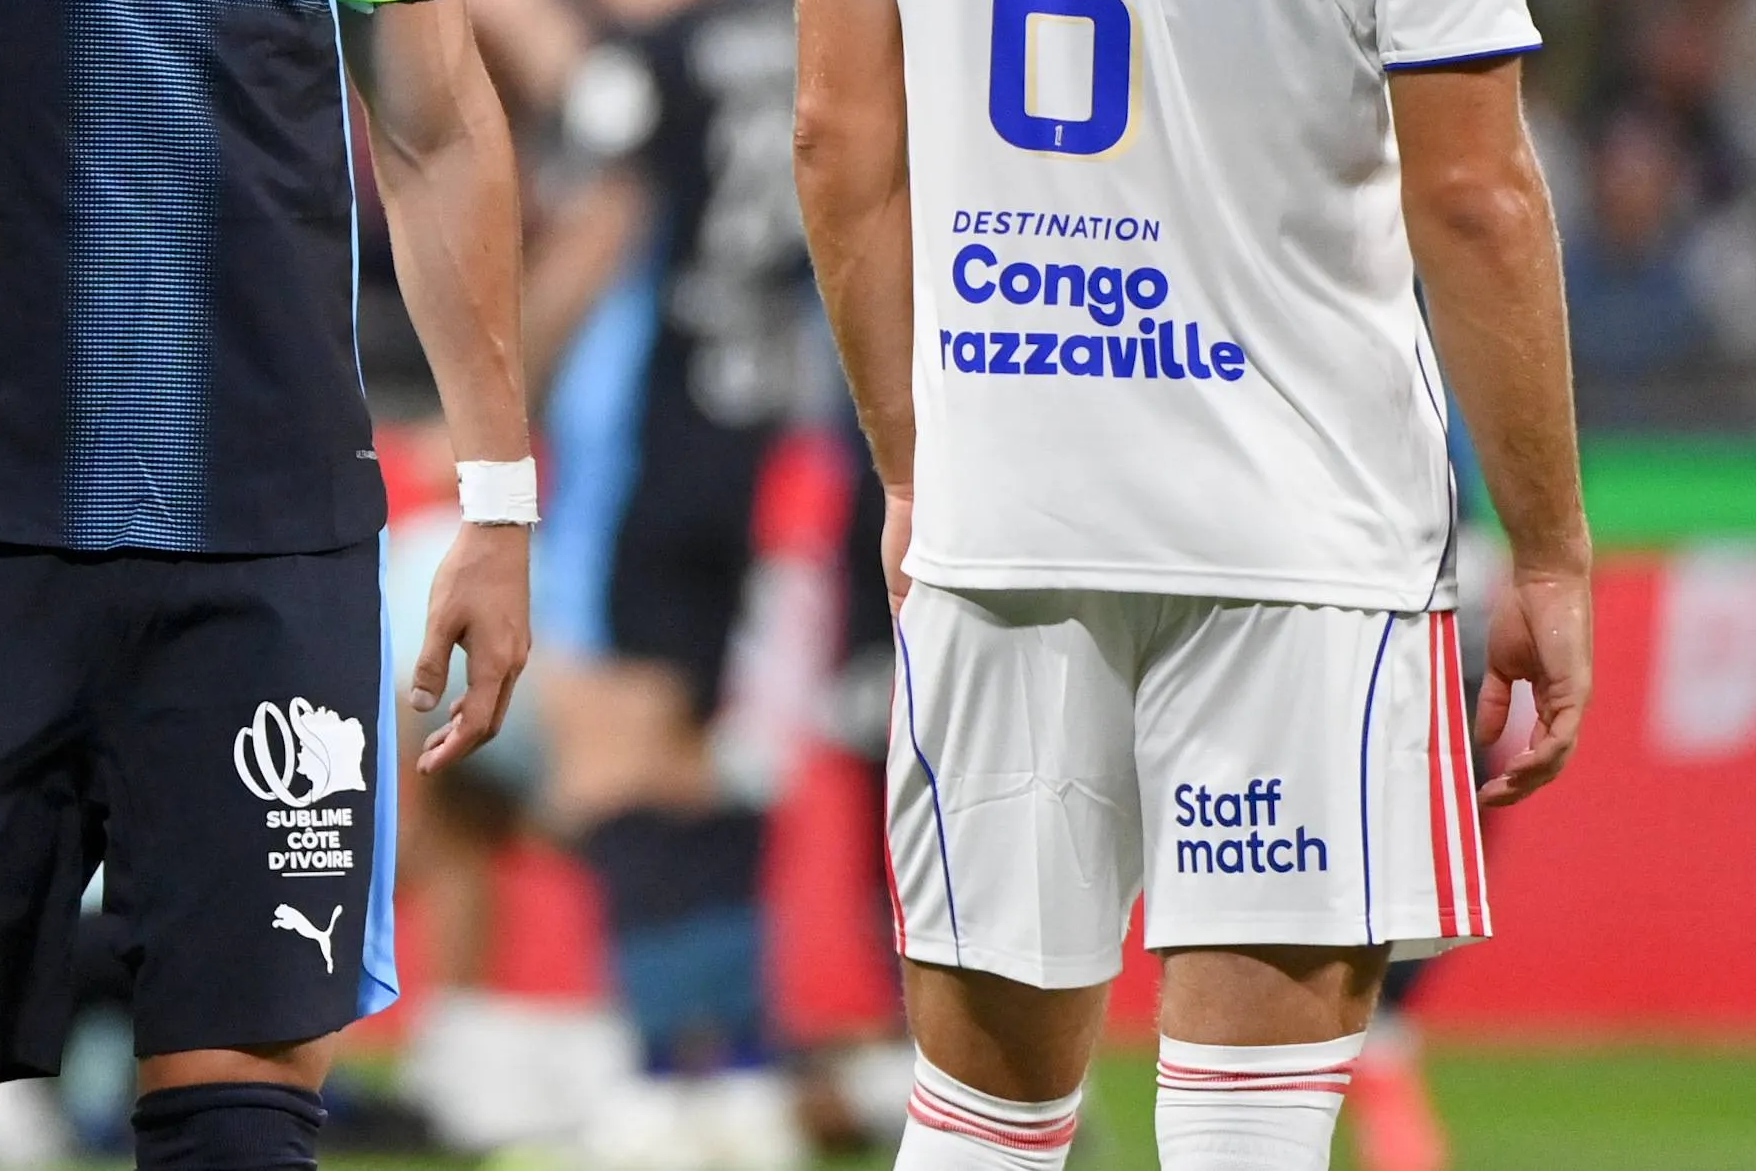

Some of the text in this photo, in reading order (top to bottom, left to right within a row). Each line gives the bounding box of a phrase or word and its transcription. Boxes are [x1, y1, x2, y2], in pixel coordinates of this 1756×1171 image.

[952, 211, 1160, 242] DESTINATION
[952, 243, 1169, 327] Congo
[939, 317, 1245, 382] razzaville
[266, 808, 353, 828] SUBLIME
[1175, 779, 1282, 827] Staff
[287, 827, 341, 850] CÔTE
[1177, 825, 1327, 873] match
[268, 850, 354, 870] D'IVOIRE
